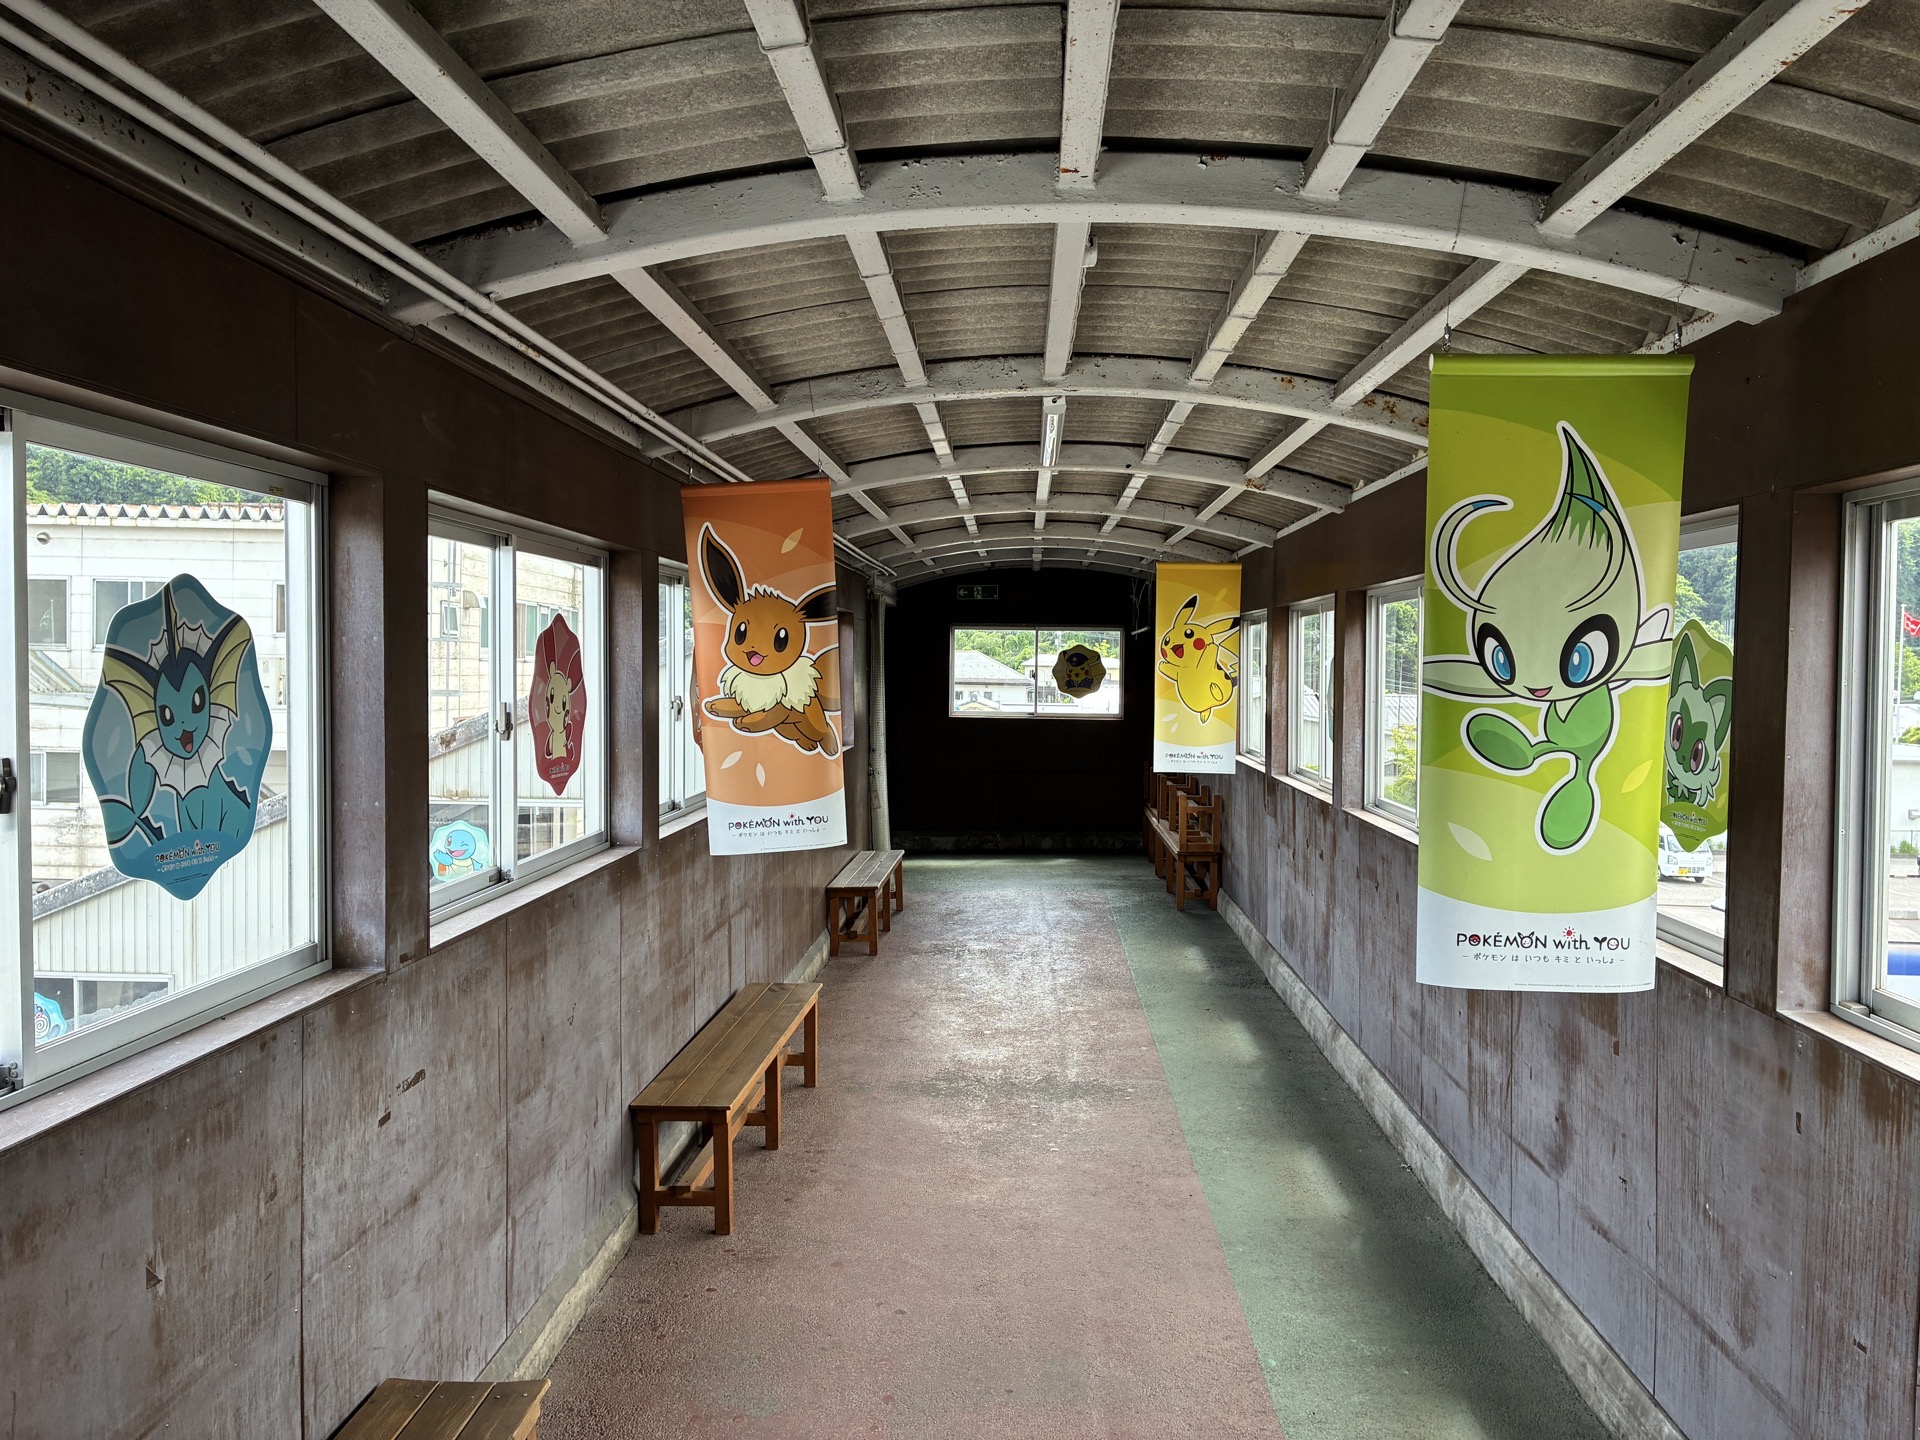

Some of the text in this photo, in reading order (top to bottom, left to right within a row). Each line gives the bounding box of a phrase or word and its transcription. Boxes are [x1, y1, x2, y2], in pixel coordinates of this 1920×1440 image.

[728, 813, 829, 830] POKÉMON with YOU
[1456, 929, 1631, 951] POKÉMON with YOU
